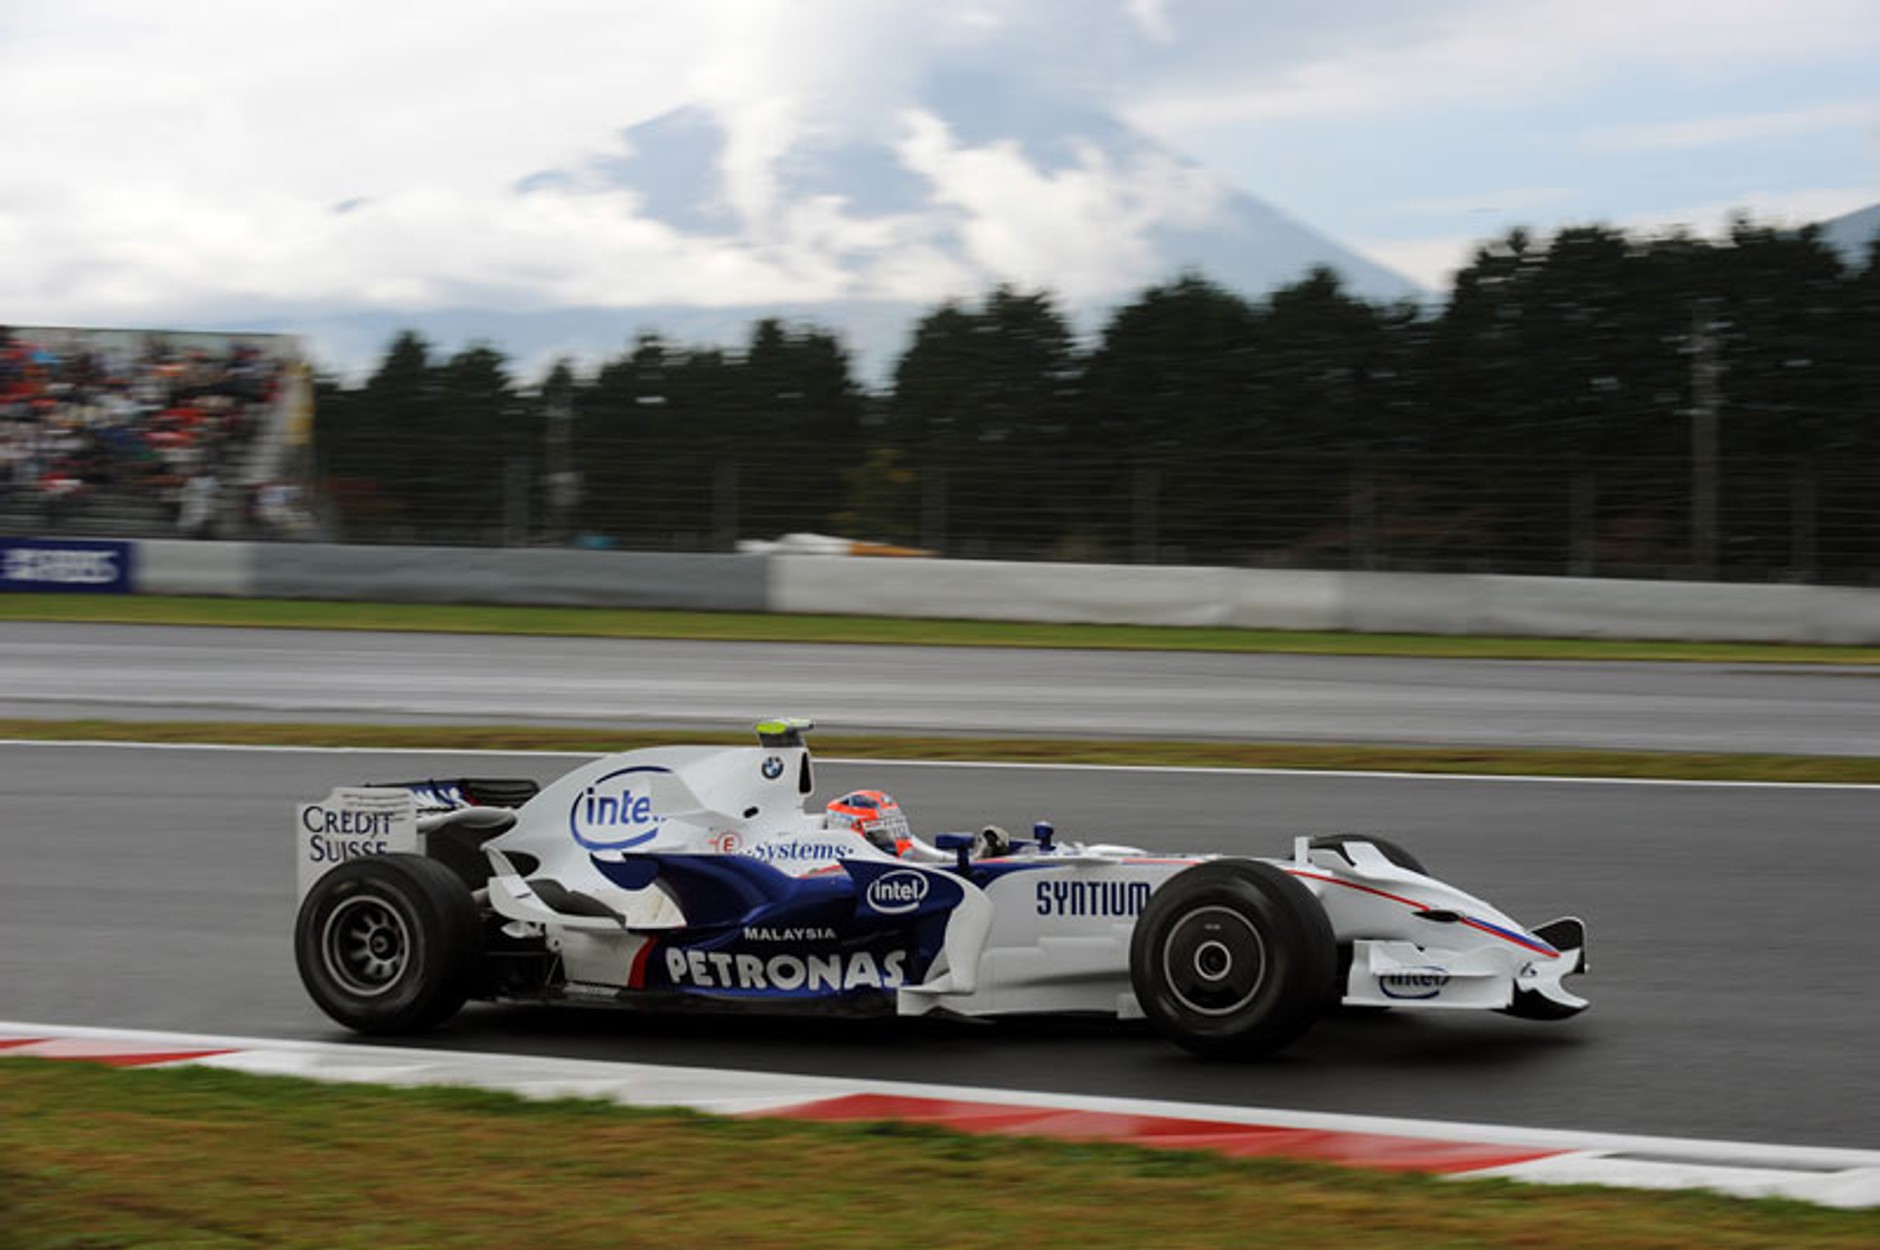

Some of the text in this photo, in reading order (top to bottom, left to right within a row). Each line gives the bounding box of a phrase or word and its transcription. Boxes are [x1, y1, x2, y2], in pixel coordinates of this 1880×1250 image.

[303, 806, 395, 834] CREDIT
[874, 879, 918, 900] intel
[1036, 881, 1151, 916] SYNTIUM
[744, 927, 836, 940] MALAYSIA
[666, 948, 906, 990] PETRONAS
